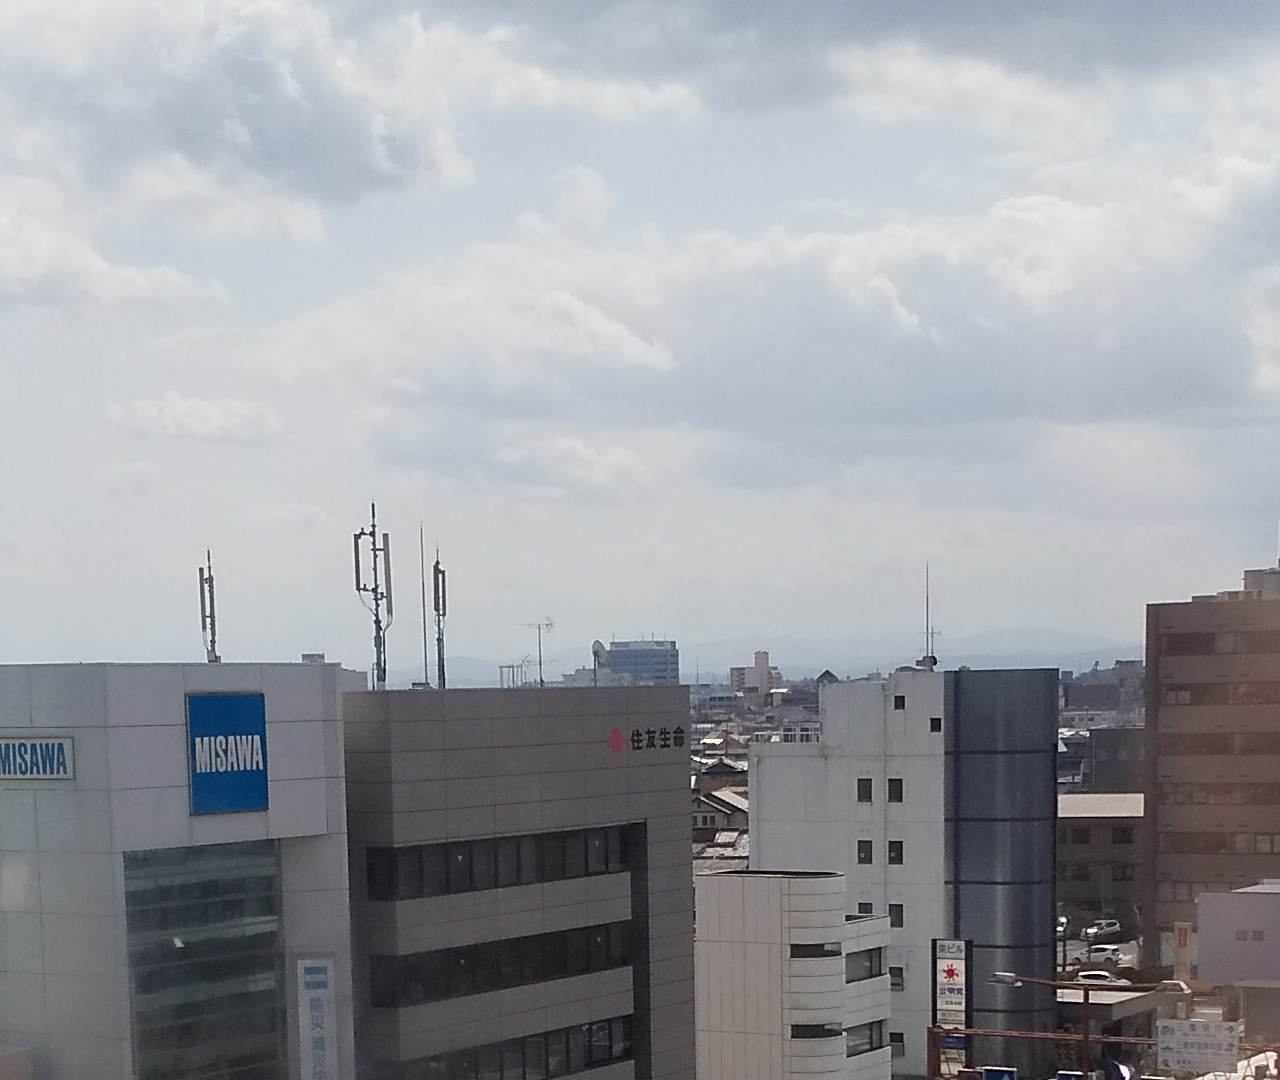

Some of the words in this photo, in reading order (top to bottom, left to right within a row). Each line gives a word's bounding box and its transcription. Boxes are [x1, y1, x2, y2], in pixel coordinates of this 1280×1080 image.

[195, 734, 264, 774] MISAWA
[630, 726, 685, 751] 住友生命
